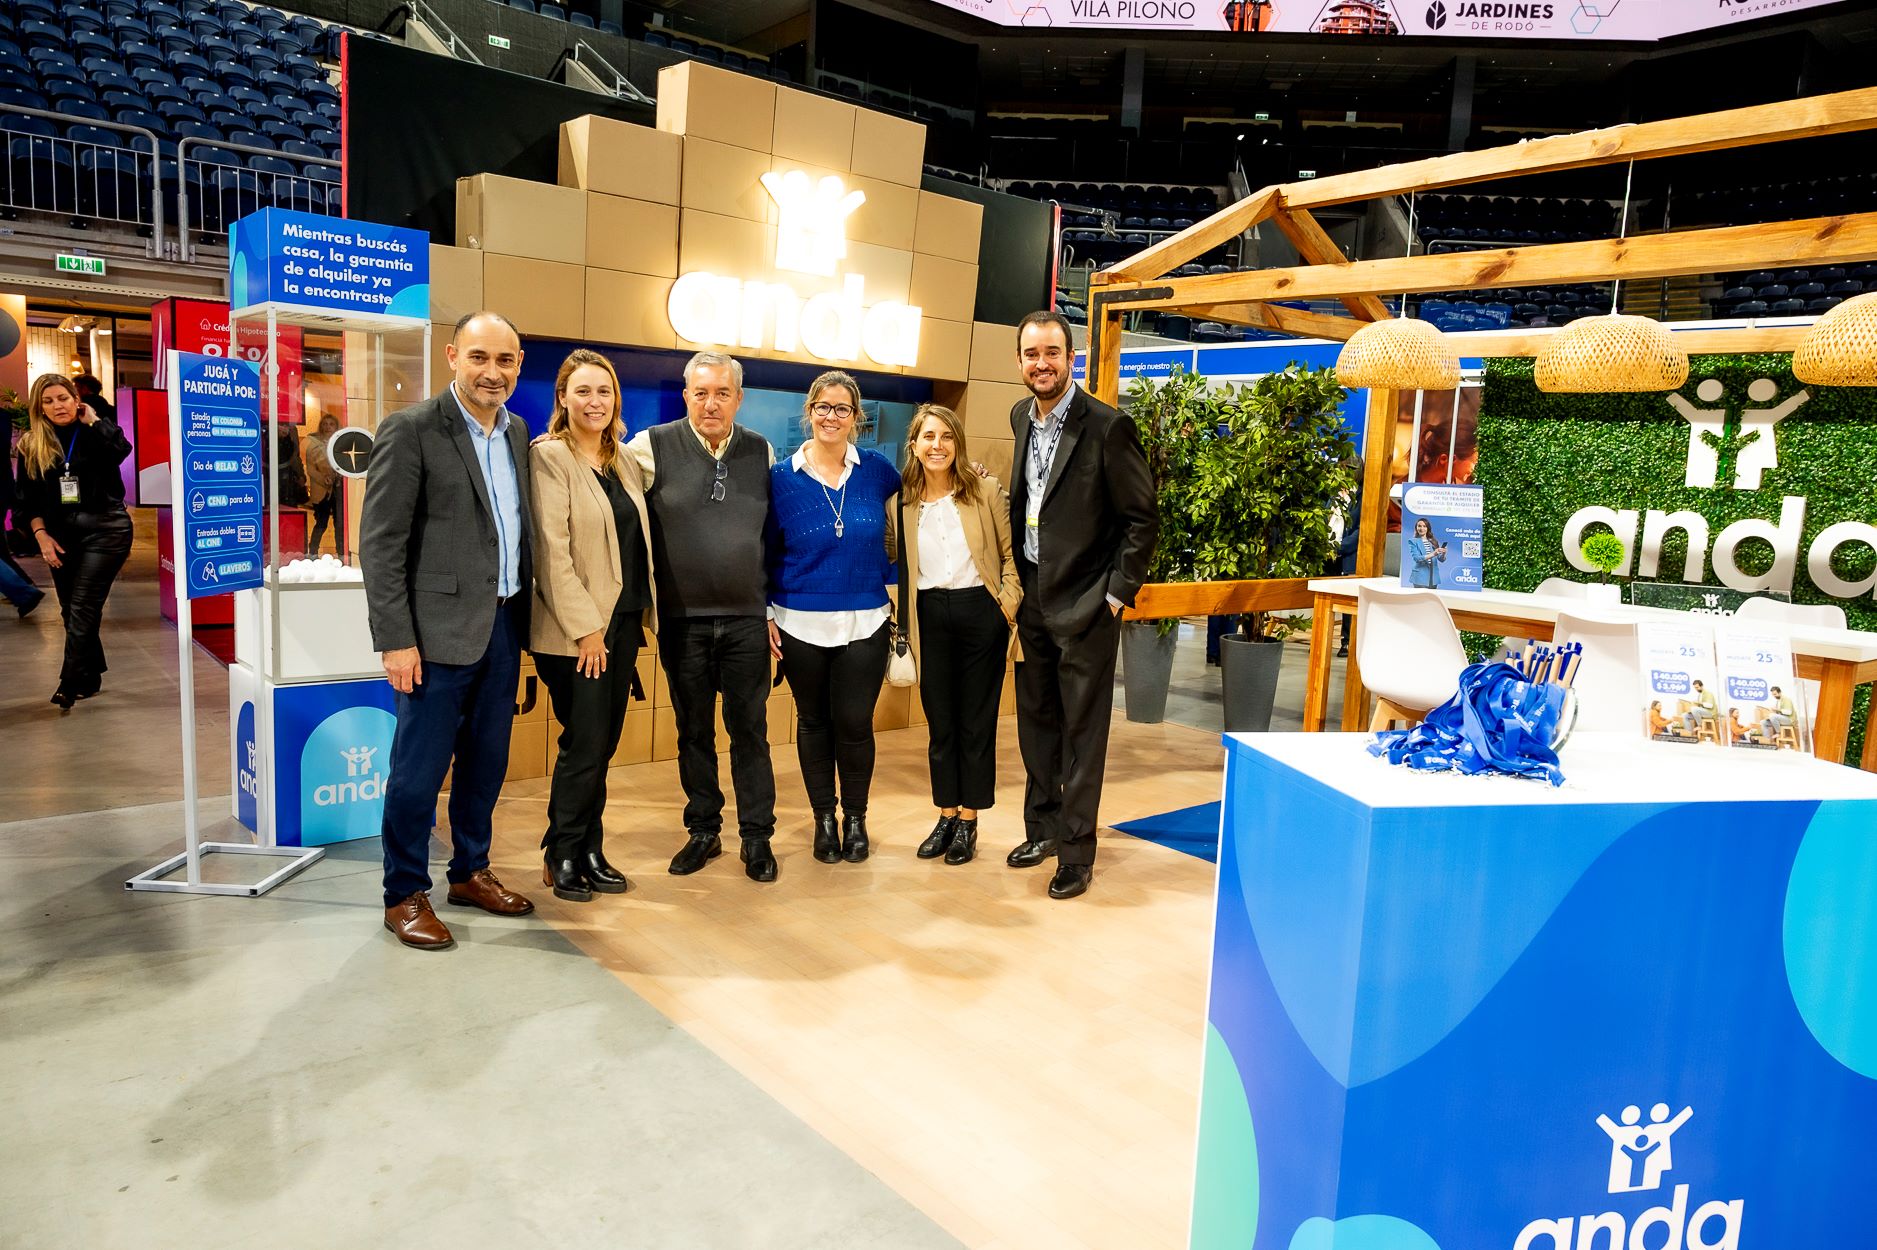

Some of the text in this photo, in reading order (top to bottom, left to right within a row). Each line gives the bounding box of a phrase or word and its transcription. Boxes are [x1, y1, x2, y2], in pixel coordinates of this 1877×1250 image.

[1070, 0, 1195, 20] VILA PILONO
[1456, 2, 1554, 19] JARDINES
[1471, 21, 1534, 31] DE RODÓ
[282, 223, 408, 254] Mientras buscás
[282, 244, 413, 272] casa, la garantía
[283, 260, 392, 288] de alquiler ya
[283, 279, 393, 305] la encontraste
[667, 271, 922, 367] anda
[203, 363, 239, 380] JUGÁ Y
[1146, 362, 1170, 371] nuestro
[184, 380, 233, 397] PARTICIPÁ
[234, 385, 256, 399] POR:
[187, 430, 211, 438] personas
[192, 421, 211, 430] para 2
[205, 460, 213, 470] de
[215, 461, 237, 471] RELAX
[208, 493, 254, 506] CENA para dos
[196, 526, 236, 538] Entradas dobles
[197, 538, 221, 548] AL CINE
[1562, 496, 1877, 600] anda
[219, 562, 251, 574] LLAVEROS
[1455, 575, 1478, 583] anda
[1512, 1184, 1744, 1250] anda
